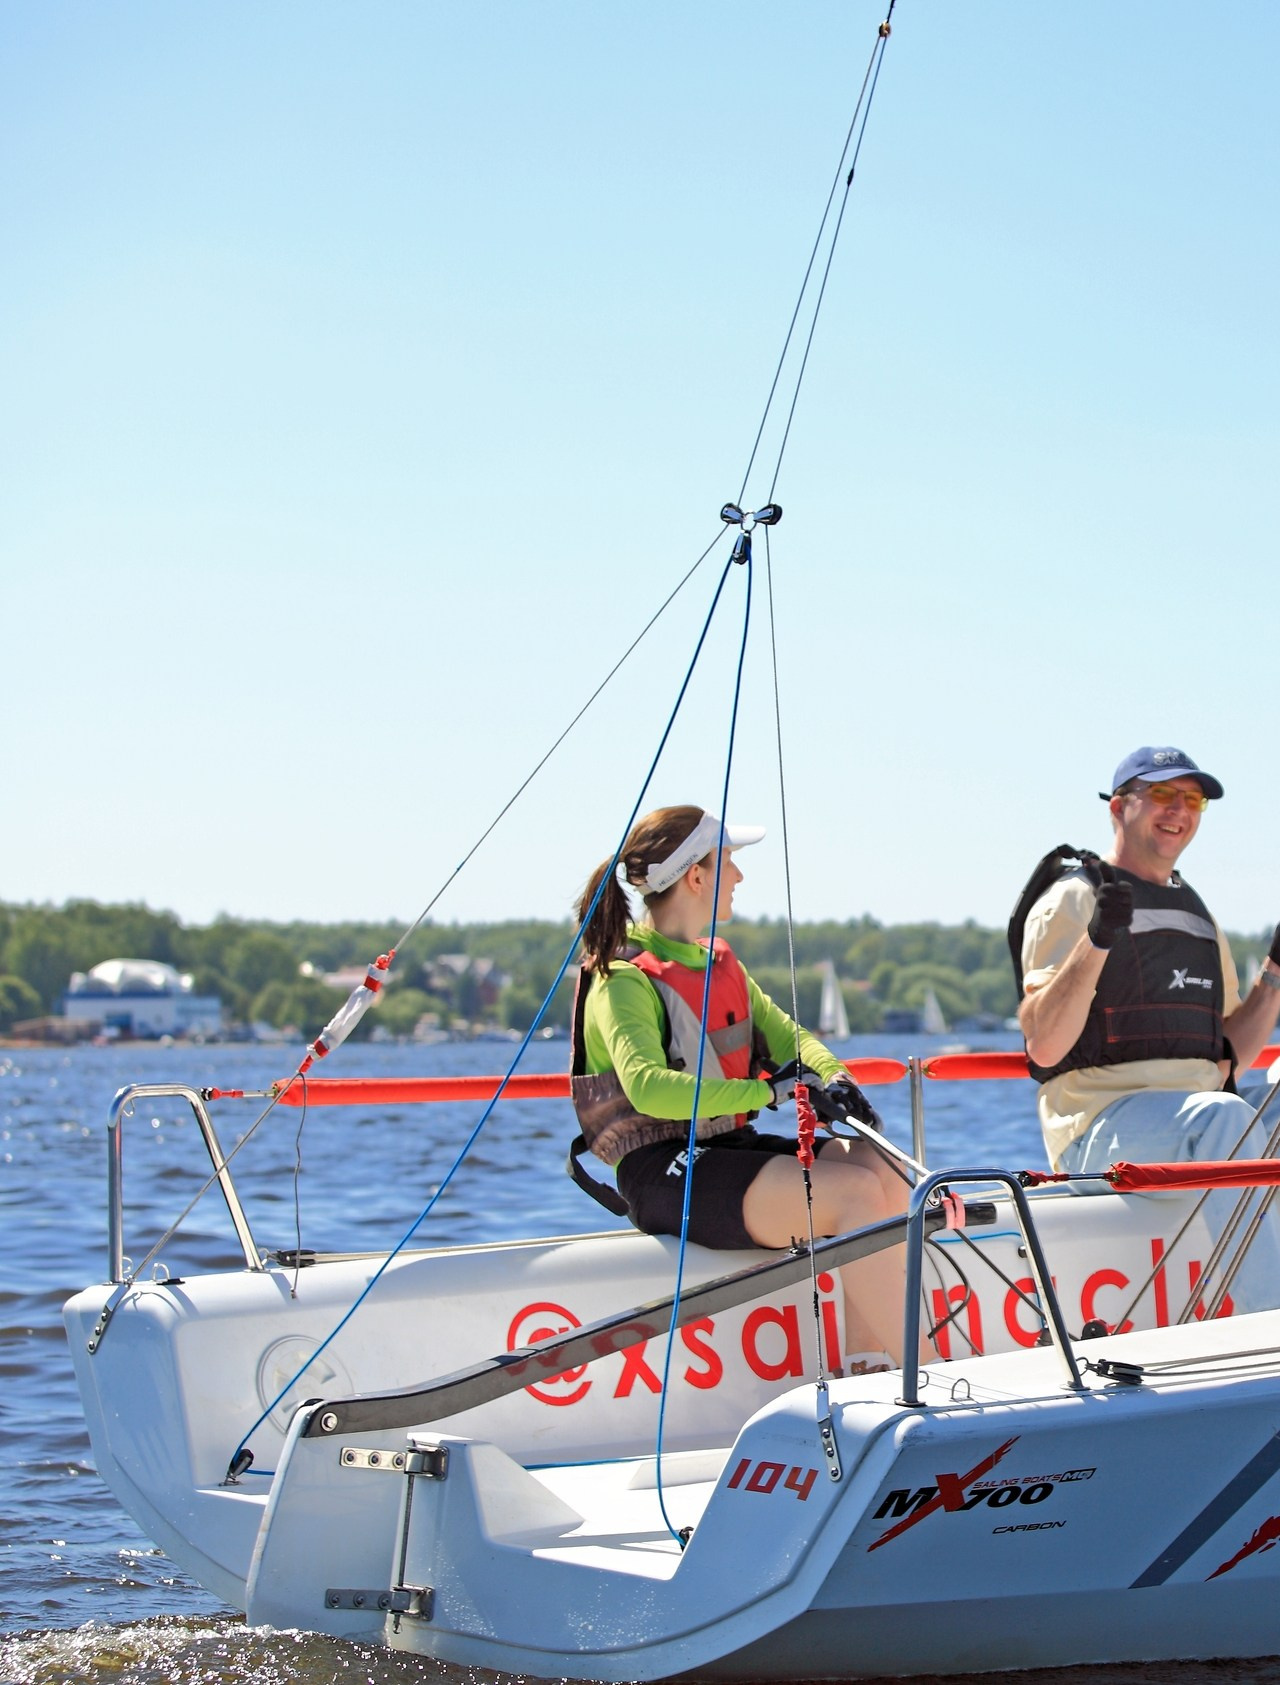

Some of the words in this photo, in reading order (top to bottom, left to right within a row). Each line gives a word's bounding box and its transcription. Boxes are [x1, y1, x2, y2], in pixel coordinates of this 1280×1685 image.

[727, 1457, 820, 1502] 104
[972, 1477, 1019, 1490] SAILING
[1022, 1473, 1063, 1485] BOATS
[992, 1520, 1067, 1535] CARBON
